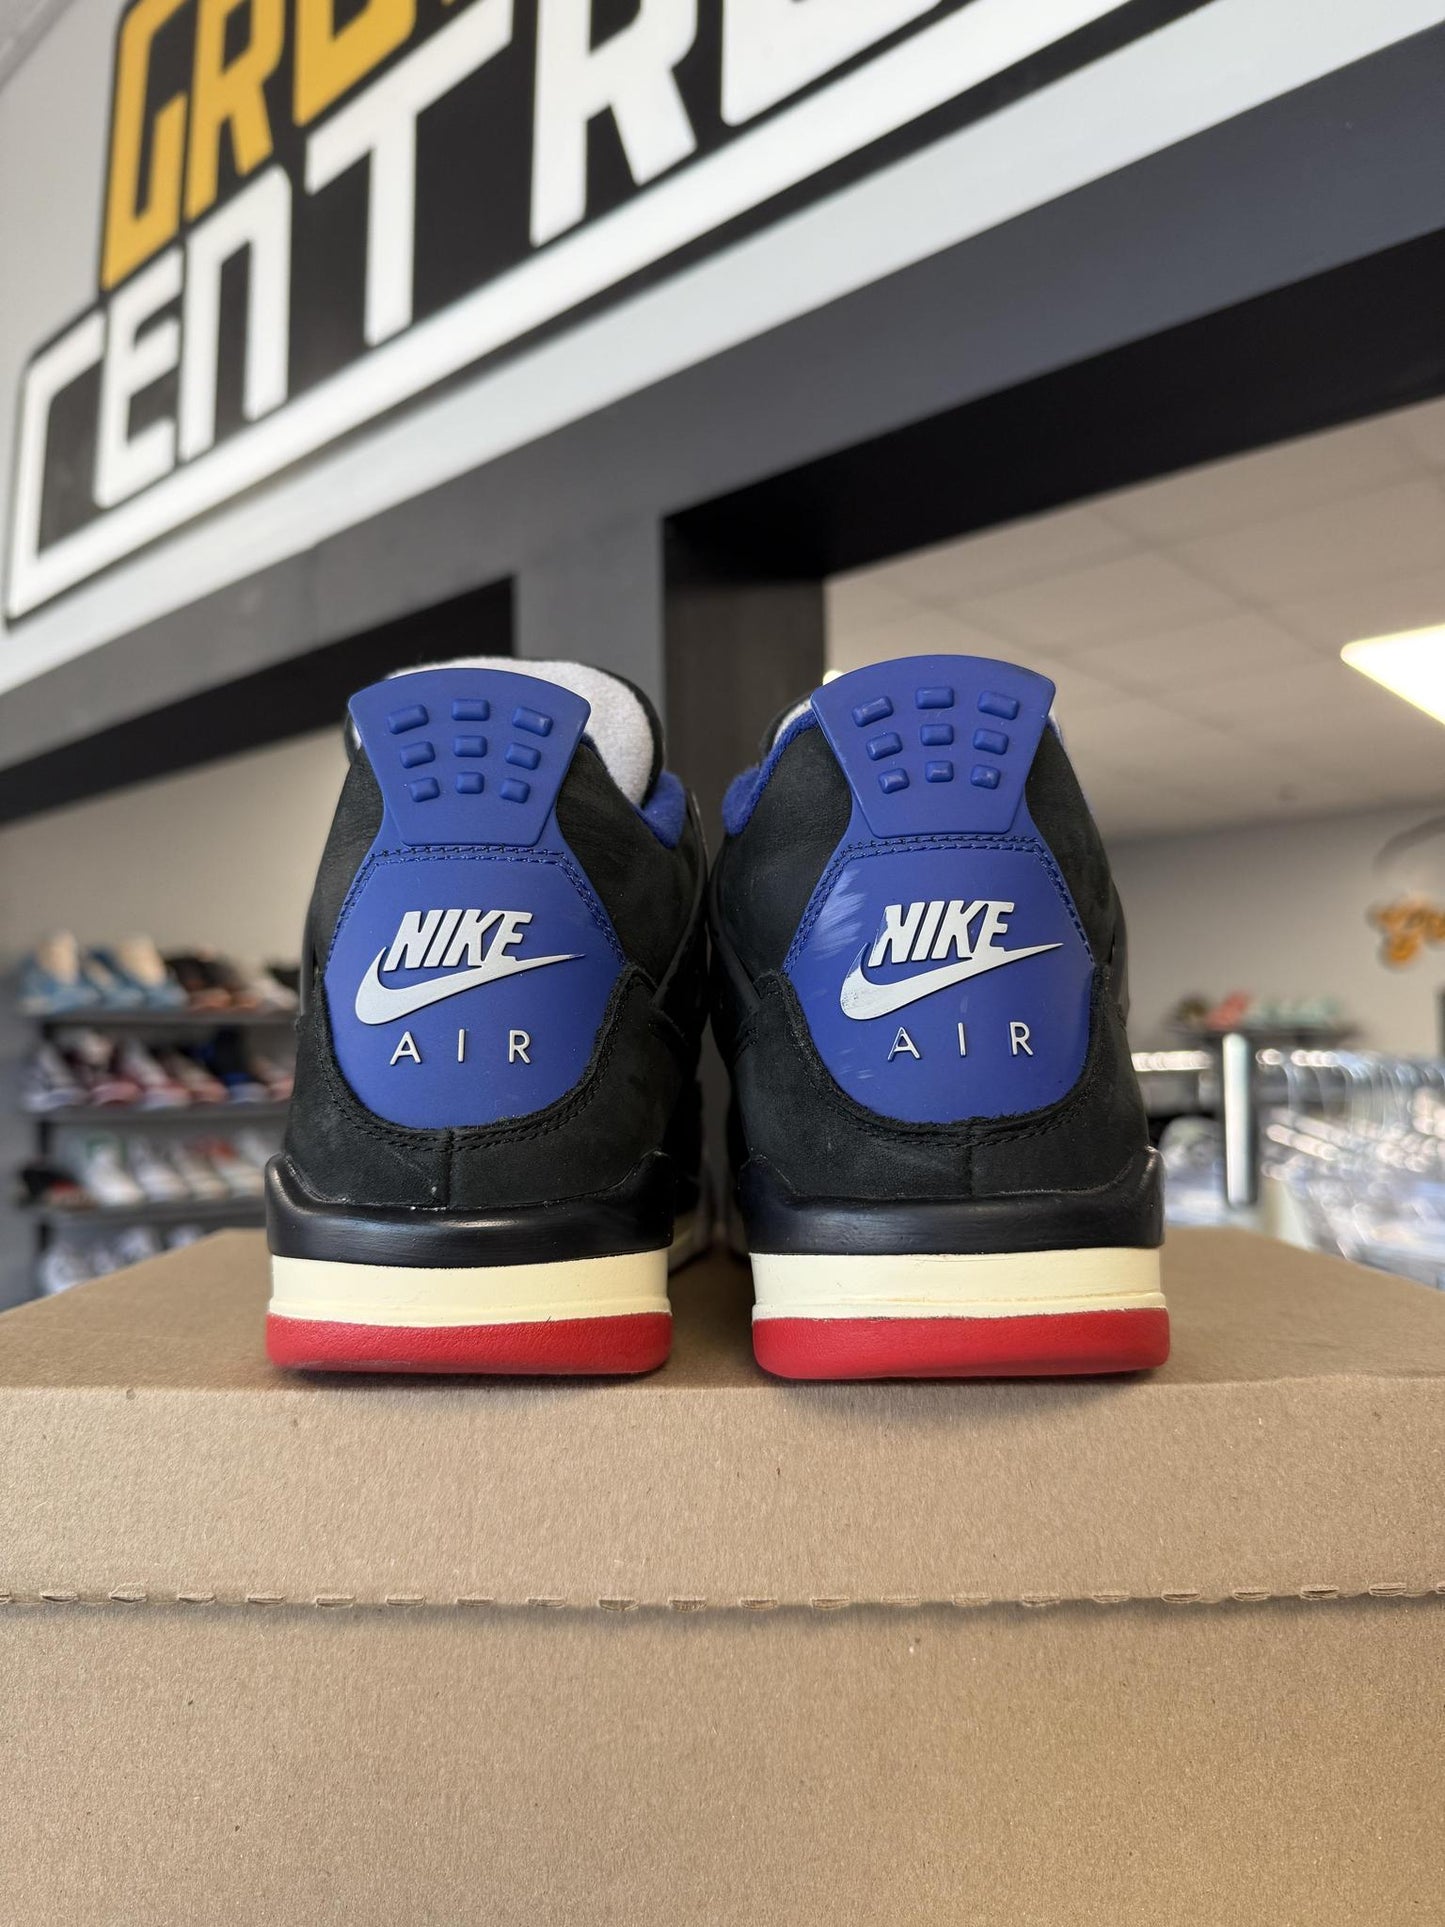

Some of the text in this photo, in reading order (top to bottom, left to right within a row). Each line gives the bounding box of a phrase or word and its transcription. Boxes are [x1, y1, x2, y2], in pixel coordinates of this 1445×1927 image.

[383, 909, 533, 972] NIKE
[867, 899, 1015, 968] NIKE
[389, 1028, 532, 1065] AIR
[887, 1021, 1034, 1061] AIR
